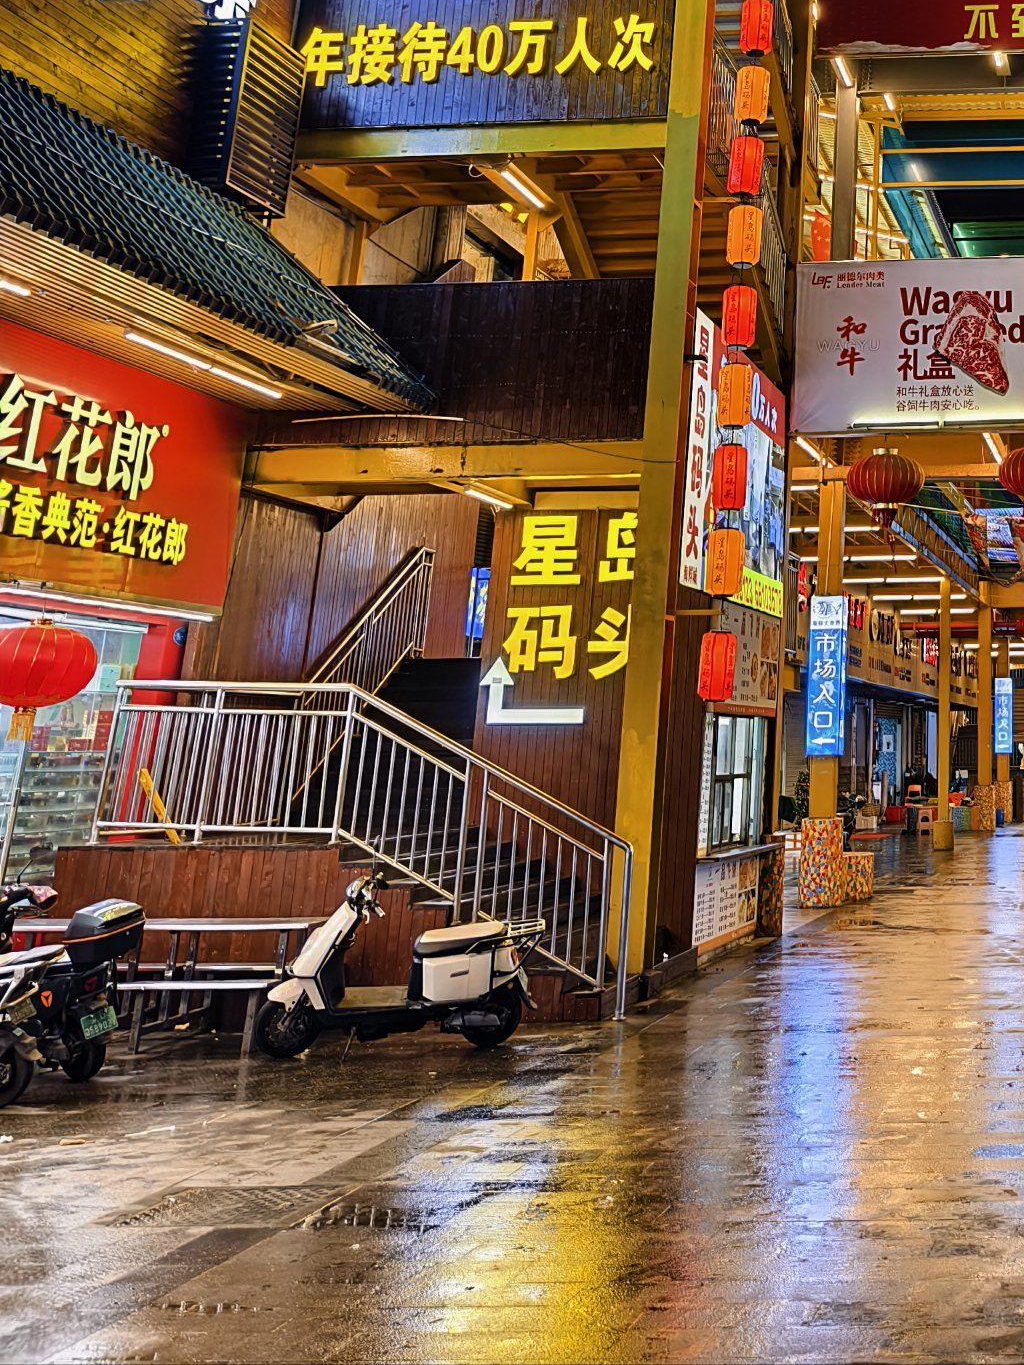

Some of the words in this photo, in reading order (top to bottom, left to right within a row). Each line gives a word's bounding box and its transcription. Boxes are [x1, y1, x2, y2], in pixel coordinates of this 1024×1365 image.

[300, 14, 655, 87] 年接待40万人次
[837, 315, 867, 376] 和牛
[897, 348, 956, 382] 礼盒
[896, 384, 975, 398] 和牛礼盒放心送
[0, 374, 161, 501] 红花郎
[511, 512, 638, 585] 星岛
[503, 604, 632, 681] 码头
[811, 632, 837, 728] 市场入口
[997, 696, 1009, 740] 市场入口
